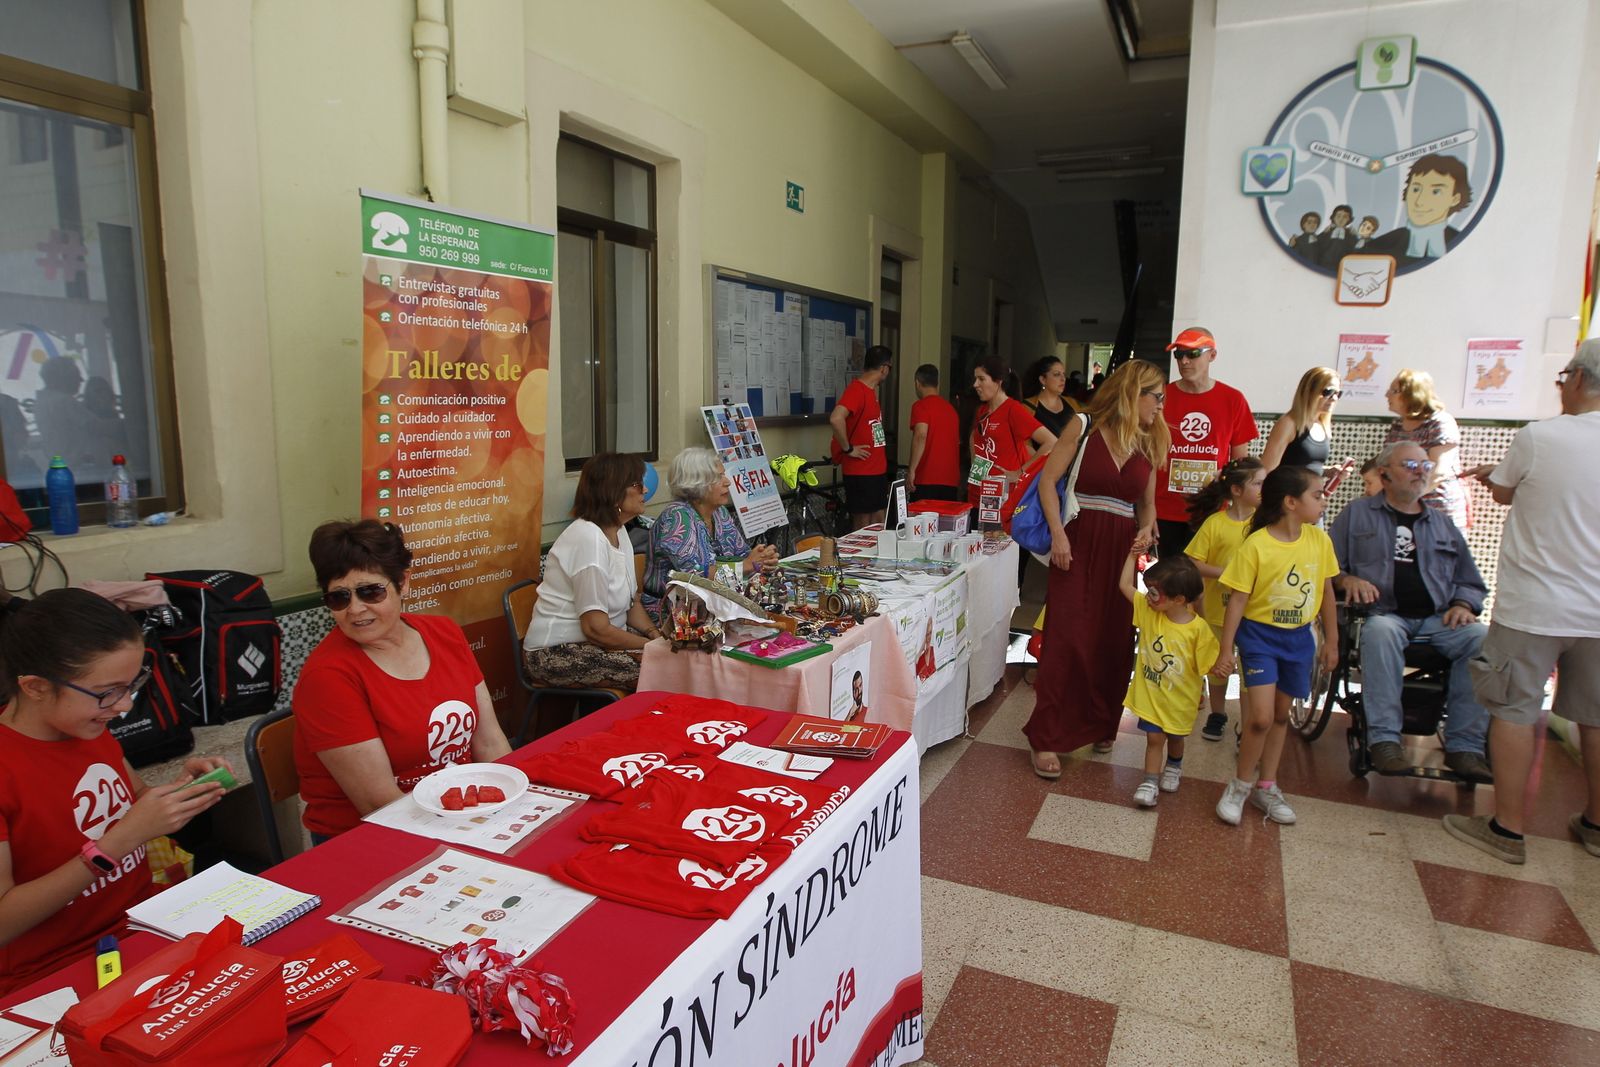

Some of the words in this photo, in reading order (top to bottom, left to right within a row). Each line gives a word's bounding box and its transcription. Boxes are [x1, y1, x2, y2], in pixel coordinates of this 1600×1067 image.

[418, 217, 464, 236] TELÉFONO
[467, 227, 480, 238] DE
[418, 232, 430, 243] LA
[431, 234, 479, 251] ESPERANZA
[418, 247, 439, 259] 950
[440, 250, 460, 262] 269
[461, 252, 480, 265] 999
[490, 260, 508, 269] sede:
[509, 262, 517, 271] C/
[517, 264, 538, 275] Francia
[538, 266, 549, 276] 131
[399, 276, 457, 294] Entrevistas
[458, 285, 500, 300] gratuitas
[398, 294, 419, 305] con
[421, 295, 488, 312] profesionales
[398, 312, 459, 329] Orientación
[461, 319, 508, 333] telefónica
[509, 322, 521, 333] 24
[522, 324, 528, 334] h
[385, 350, 490, 380] Talleres
[495, 354, 522, 381] de
[397, 393, 468, 407] Comunicación
[471, 394, 506, 407] positiva
[397, 412, 440, 425] Cuidado
[442, 412, 451, 423] al
[453, 411, 497, 423] cuidador.
[1181, 417, 1210, 434] 22q
[397, 430, 463, 446] Aprendiendo
[464, 431, 471, 440] a
[473, 428, 493, 439] vivir
[494, 429, 511, 439] con
[397, 449, 408, 461] la
[410, 445, 472, 461] enfermedad.
[1169, 444, 1219, 455] Andalucía
[397, 464, 458, 480] Autoestima.
[397, 484, 454, 499] Inteligencia
[456, 477, 506, 492] emocional.
[397, 504, 414, 517] Los
[416, 501, 442, 514] retos
[444, 499, 456, 511] de
[458, 497, 491, 509] educar
[492, 493, 510, 506] hoy.
[399, 519, 453, 535] Autonomía
[454, 513, 493, 528] afectiva.
[404, 534, 452, 552] eparación
[453, 529, 492, 544] afectiva.
[410, 550, 461, 568] rendiendo
[462, 550, 468, 559] a
[469, 545, 492, 557] vivir,
[410, 566, 454, 580] complicamos
[461, 559, 478, 570] vida?
[402, 582, 447, 600] lajación
[449, 576, 474, 590] como
[476, 569, 513, 584] remedio
[408, 598, 441, 613] estrés.
[733, 774, 908, 1030] SÍNDROME
[285, 959, 351, 995] dalucía
[296, 976, 343, 1001] Google
[342, 966, 360, 977] It!
[142, 962, 245, 1034] Andalucía
[155, 1019, 190, 1041] Just
[188, 980, 241, 1018] Google
[238, 966, 259, 980] It!
